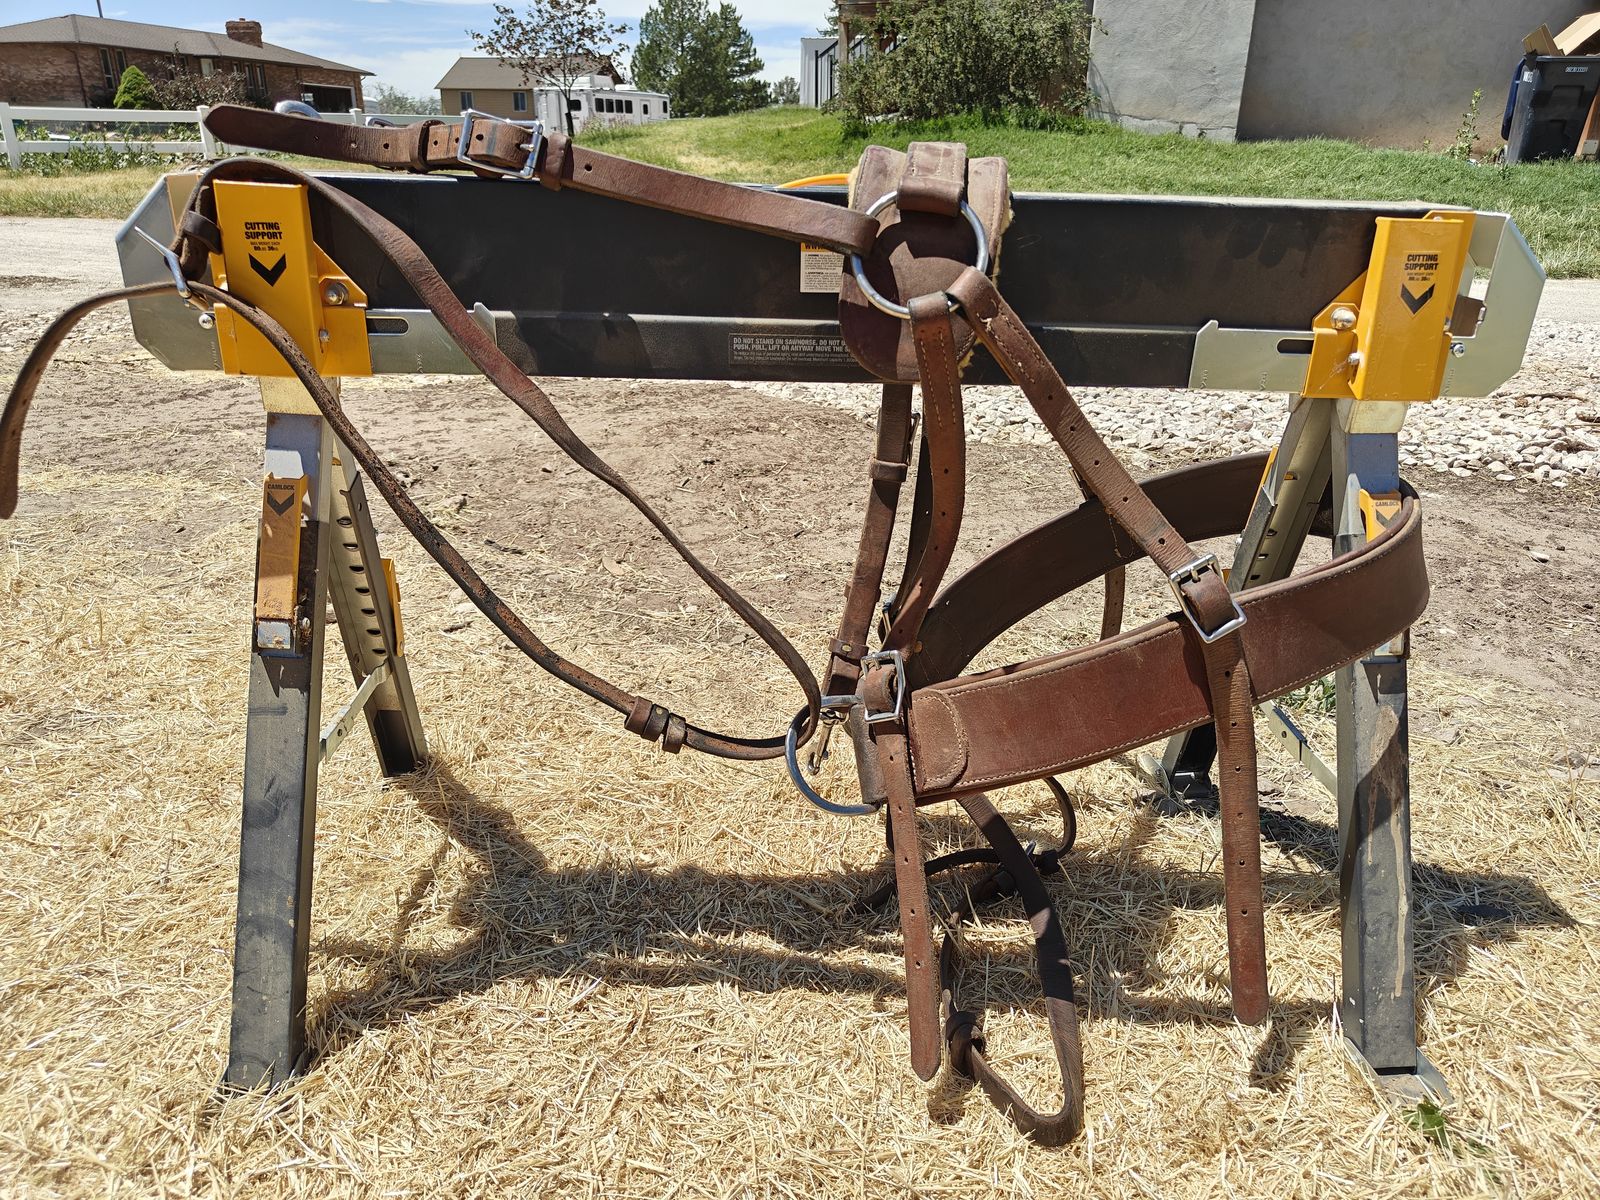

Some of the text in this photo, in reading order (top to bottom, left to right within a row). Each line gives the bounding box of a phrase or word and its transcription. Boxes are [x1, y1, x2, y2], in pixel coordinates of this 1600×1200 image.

[244, 222, 280, 231] CUTTING
[244, 231, 282, 240] SUPPORT
[1407, 254, 1438, 262] CUTTING
[1404, 262, 1439, 271] SUPPORT
[733, 337, 742, 345] DO
[267, 483, 295, 491] CAMLOCK
